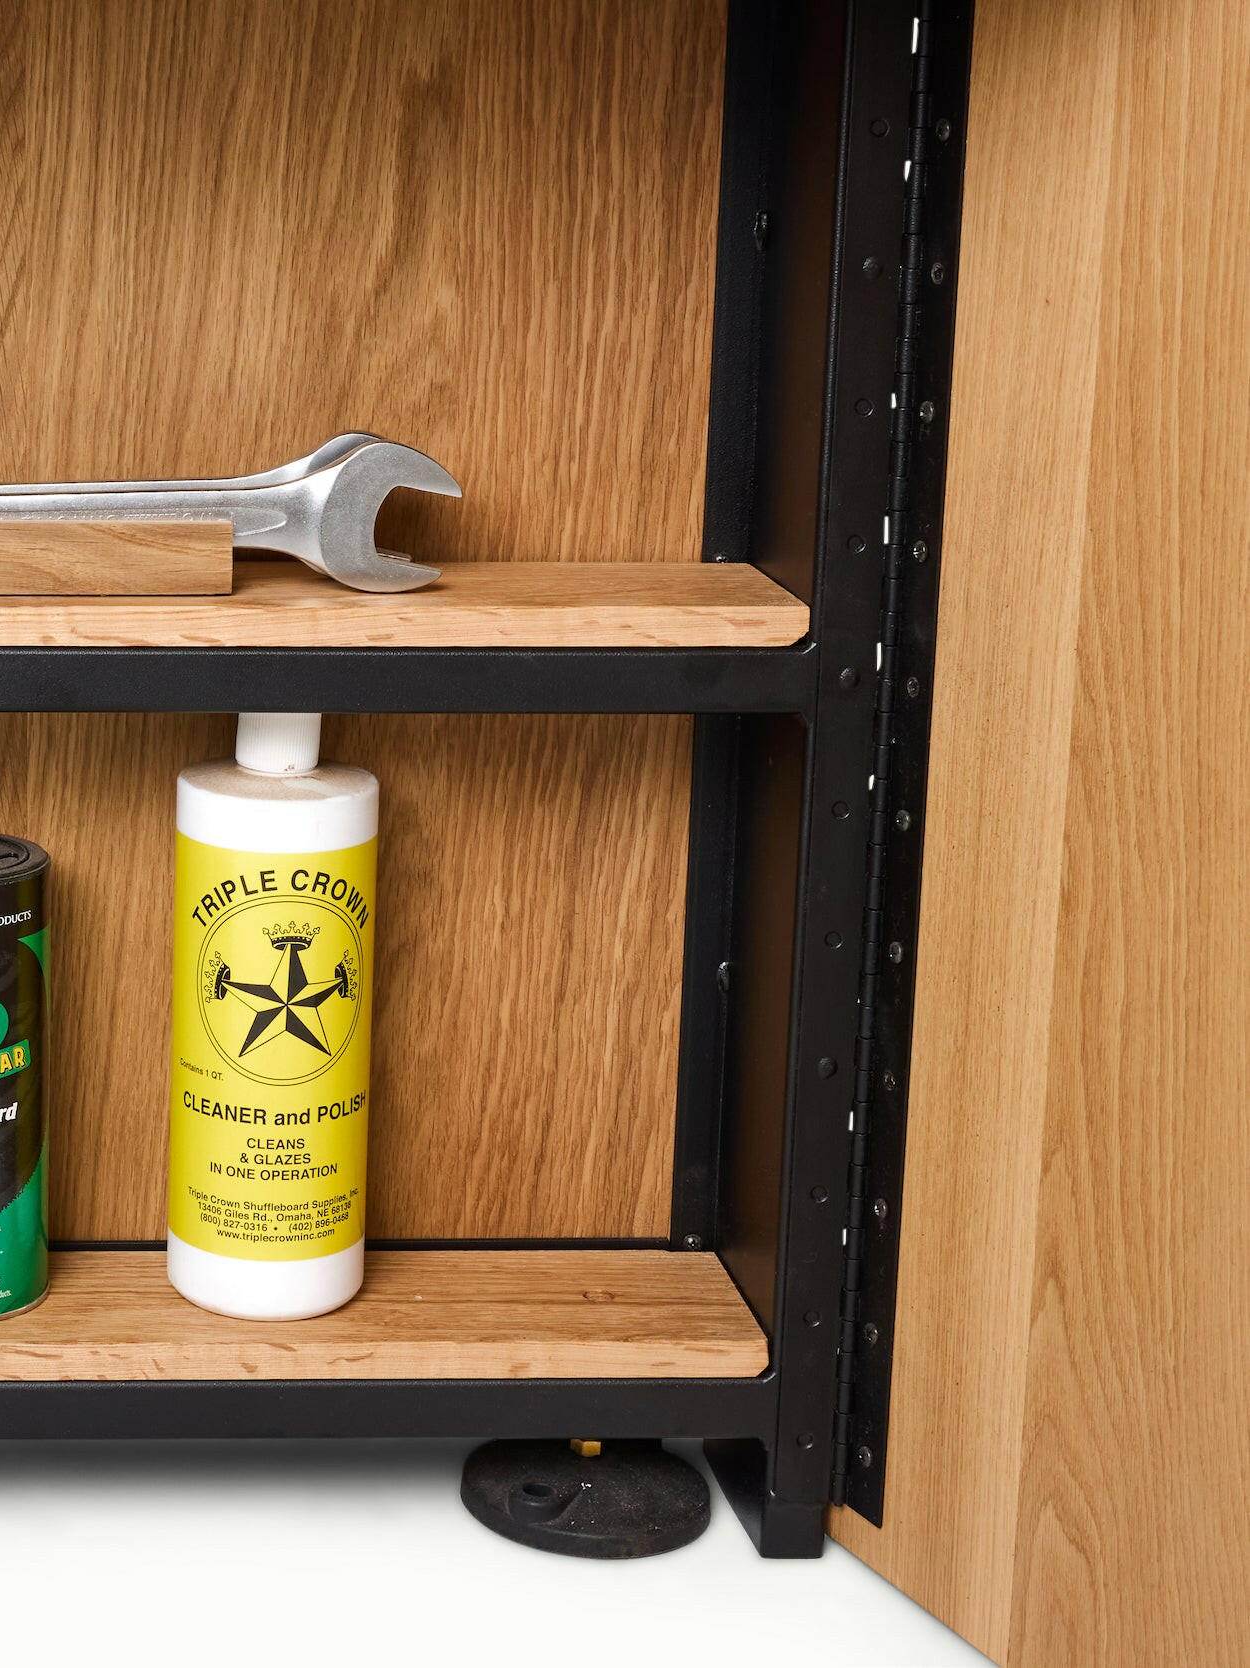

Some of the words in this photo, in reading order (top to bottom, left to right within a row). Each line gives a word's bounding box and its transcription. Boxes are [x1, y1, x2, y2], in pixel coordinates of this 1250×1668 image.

[192, 870, 277, 927] TRIPLE
[291, 869, 369, 929] CROWN
[179, 1058, 203, 1076] Contains
[211, 1071, 224, 1081] QT.
[183, 1091, 266, 1125] CLEANER
[274, 1108, 310, 1125] and
[318, 1090, 366, 1122] POLISH
[247, 1138, 305, 1150] CLEANS
[240, 1153, 248, 1163] &
[254, 1153, 311, 1164] GLAZES
[210, 1162, 222, 1174] IN
[226, 1166, 255, 1180] ONE
[260, 1163, 337, 1180] OPERATION
[188, 1186, 208, 1201] Triple
[210, 1195, 240, 1208] Crown
[244, 1202, 308, 1211] Shuffleboard
[198, 1202, 222, 1215] 13406
[225, 1209, 249, 1220] Giles
[253, 1213, 272, 1222] Rd.,
[276, 1213, 313, 1221] Omaha,
[317, 1209, 329, 1217] NE
[200, 1212, 221, 1227] (800)
[223, 1219, 268, 1231] 827-0316
[289, 1222, 312, 1233] (402)
[217, 1228, 334, 1243] www.triplecrowninc.com
